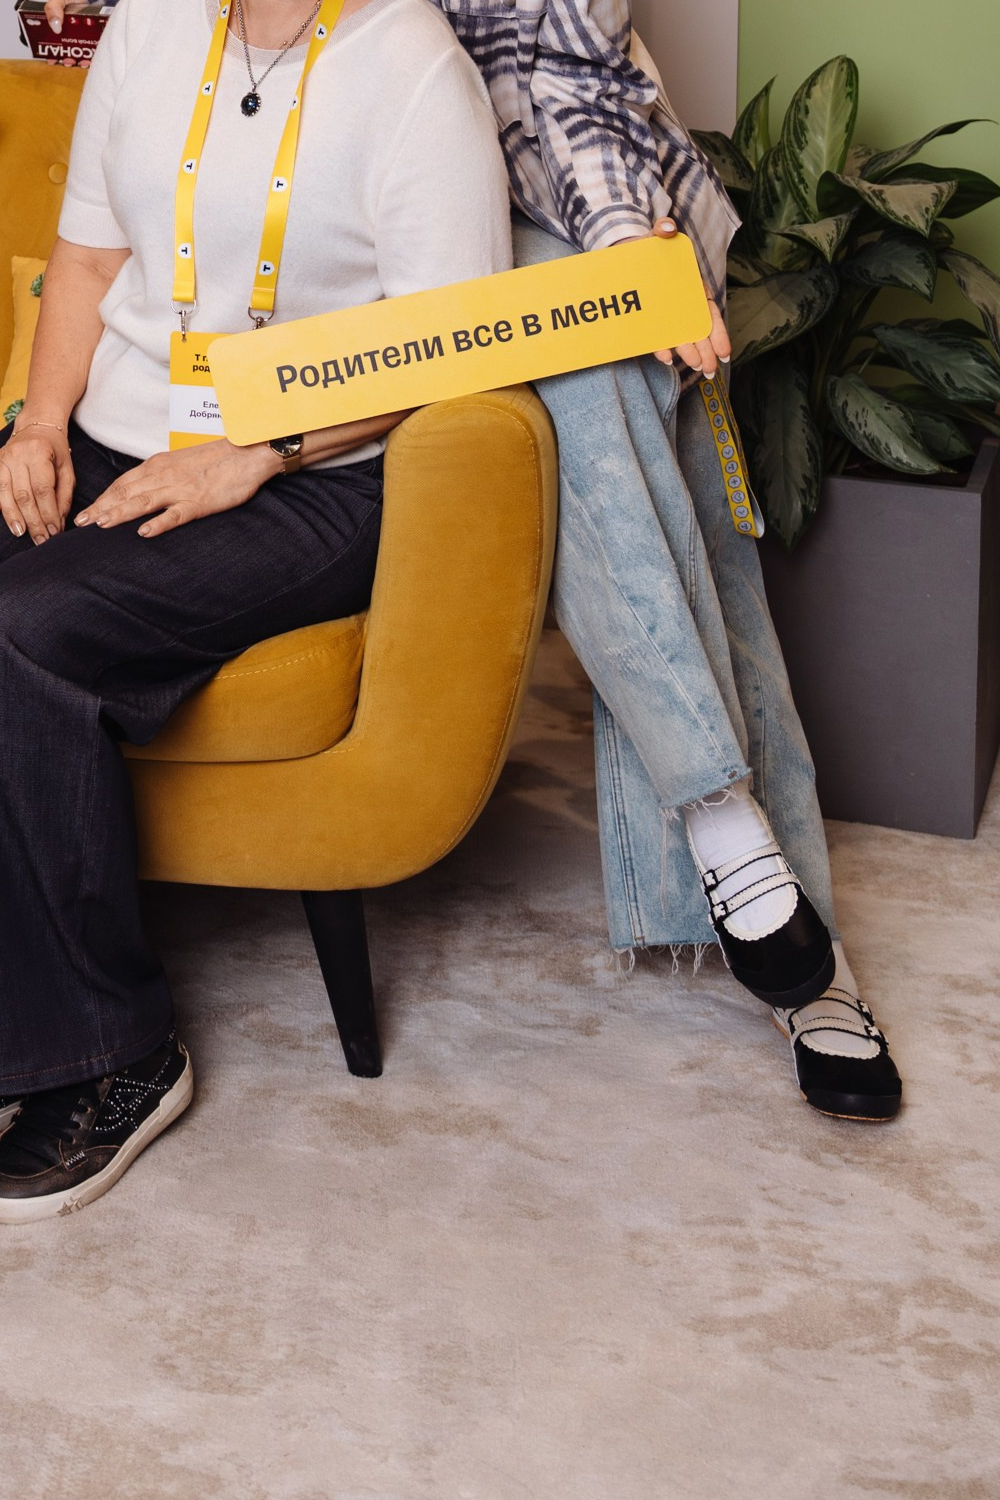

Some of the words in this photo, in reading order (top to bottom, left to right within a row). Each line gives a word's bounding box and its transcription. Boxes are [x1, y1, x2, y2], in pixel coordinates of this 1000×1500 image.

[38, 44, 96, 58] СОНАЛ
[275, 332, 444, 394] Родители
[451, 319, 514, 353] все
[521, 311, 543, 338] в
[549, 289, 643, 331] меня
